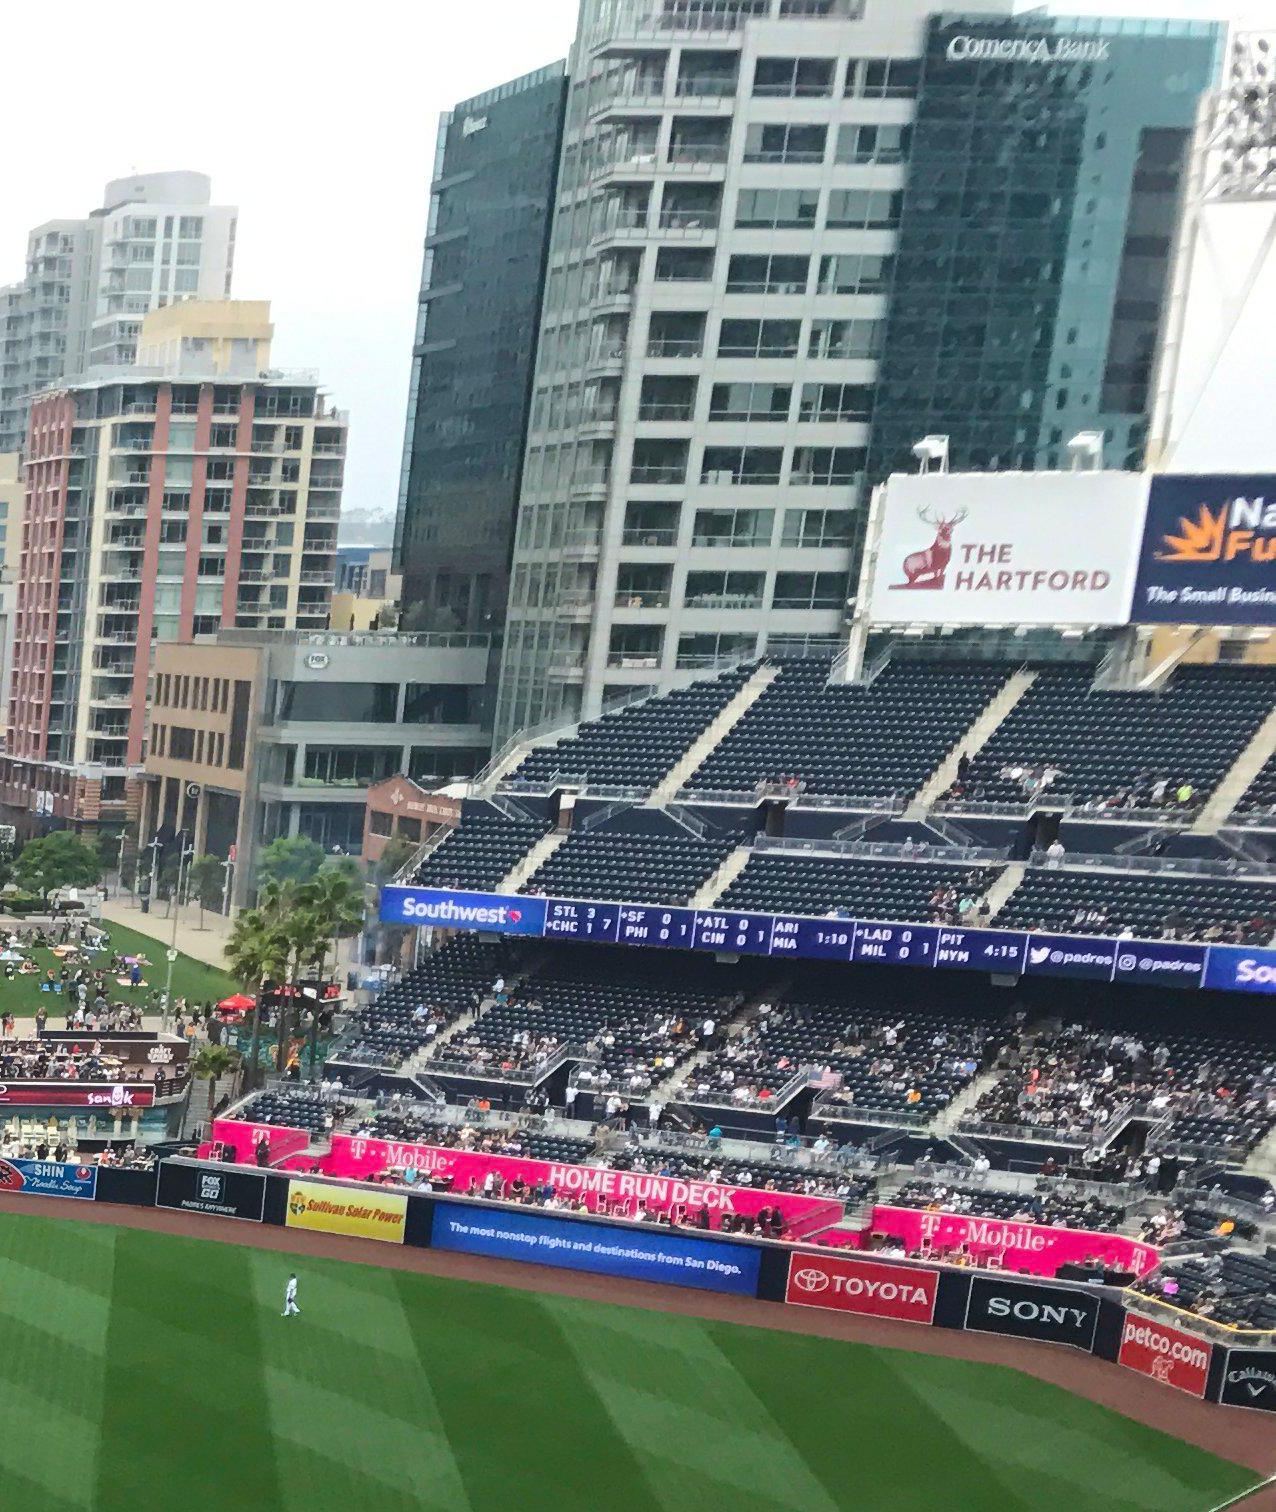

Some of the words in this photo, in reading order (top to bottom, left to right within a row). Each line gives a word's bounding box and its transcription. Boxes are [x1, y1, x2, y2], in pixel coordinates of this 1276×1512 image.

[1050, 38, 1111, 61] Bank
[961, 543, 1014, 564] THE
[954, 569, 1110, 592] HARTFORD
[1146, 586, 1178, 604] The
[1182, 586, 1225, 604] Small
[402, 897, 507, 925] Southwest
[554, 905, 578, 918] STL
[587, 907, 595, 919] 3
[941, 933, 965, 946] PIT
[938, 950, 970, 963] NYM
[984, 944, 1019, 958] 4:15
[1050, 950, 1113, 966] @padres
[1138, 958, 1202, 973] @padres
[34, 1163, 64, 1178] SHIN
[202, 1175, 221, 1185] FOX
[60, 1178, 82, 1195] Soup
[201, 1189, 219, 1199] GO
[550, 1166, 616, 1195] HOME
[620, 1174, 669, 1202] RUN
[672, 1182, 736, 1211] DECK
[306, 1199, 345, 1217] Sullivan
[345, 1204, 372, 1220] Solar
[371, 1209, 404, 1226] Power
[449, 1221, 468, 1235] The
[469, 1224, 495, 1239] most
[496, 1229, 538, 1247] nonstop
[538, 1234, 570, 1250] flights
[572, 1239, 592, 1252] and
[593, 1242, 656, 1262] destinations
[657, 1250, 684, 1266] from
[684, 1255, 705, 1269] San
[706, 1259, 742, 1276] Diego.
[832, 1274, 929, 1306] TOYOTA
[986, 1296, 1089, 1329] SONY
[1124, 1323, 1207, 1370] petco.com
